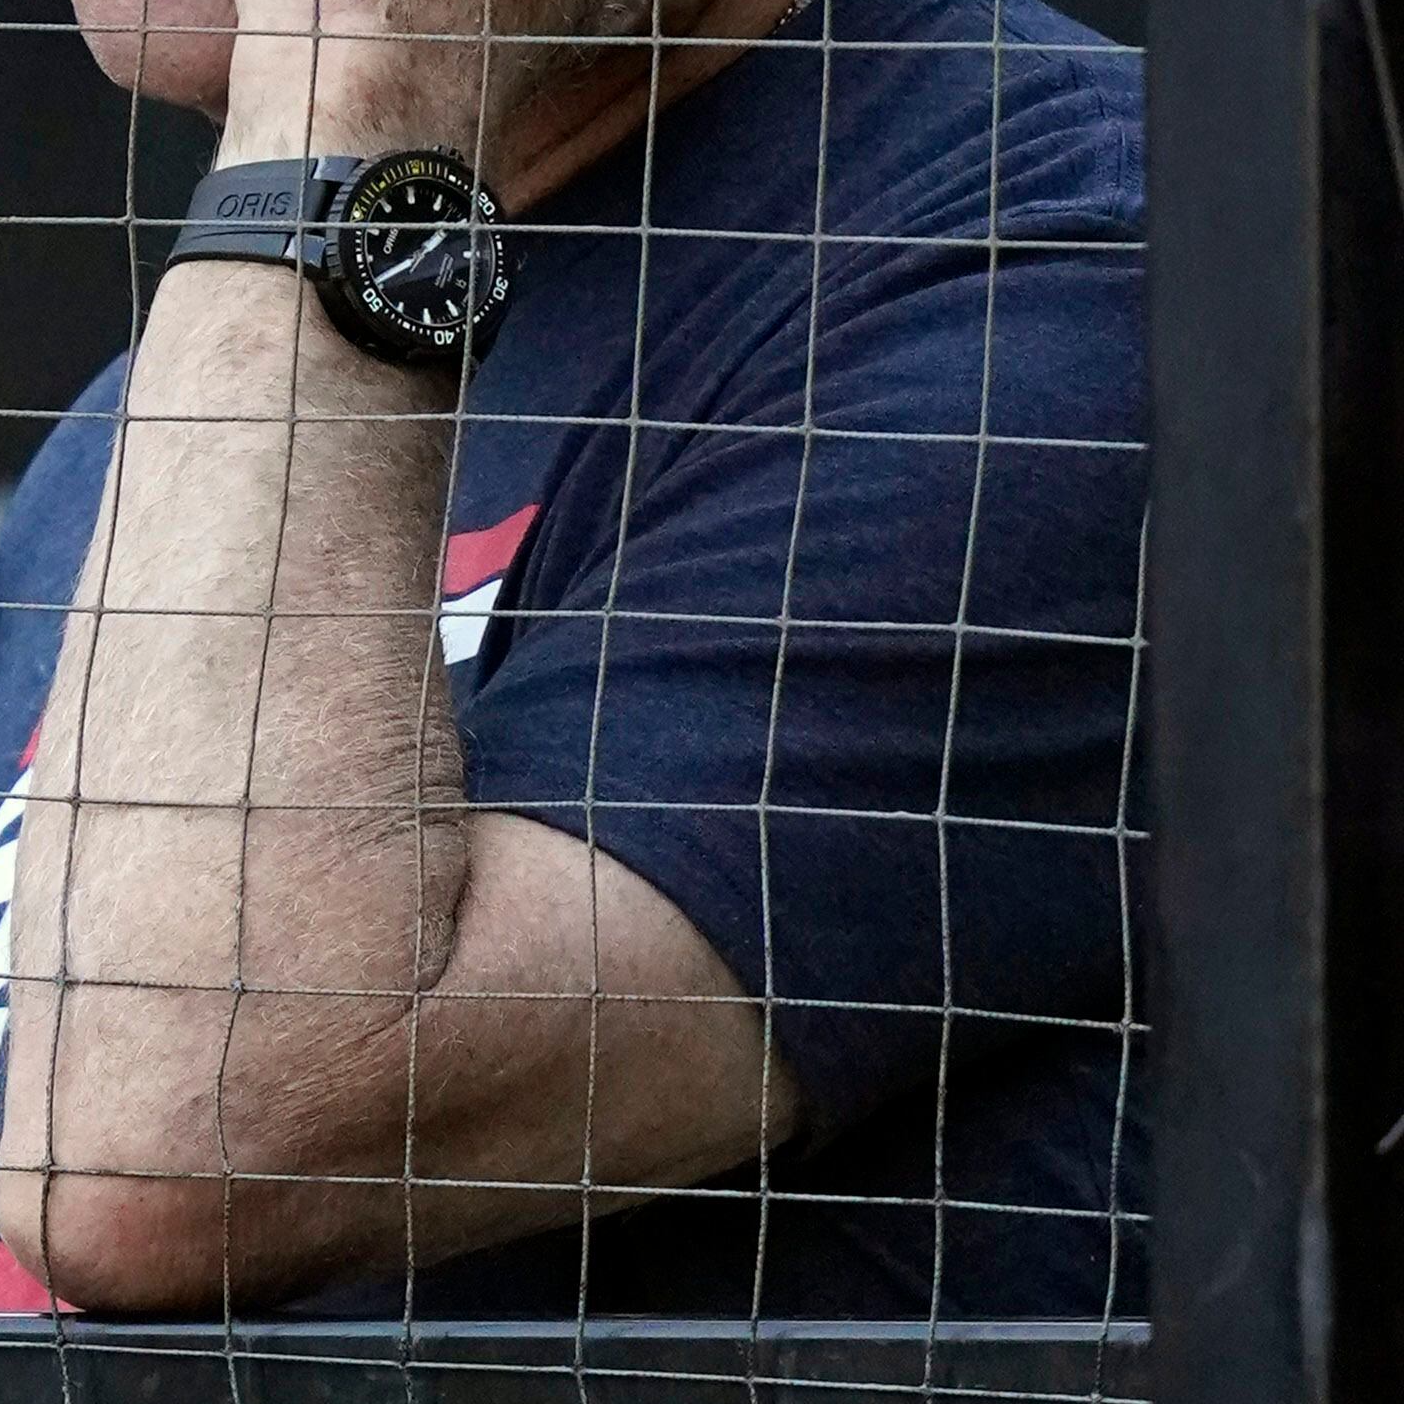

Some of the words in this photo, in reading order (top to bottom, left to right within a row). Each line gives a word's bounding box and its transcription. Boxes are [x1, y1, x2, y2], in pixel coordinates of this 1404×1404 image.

[217, 191, 293, 218] ORIS
[478, 192, 495, 216] 20
[493, 277, 508, 300] 30
[362, 289, 383, 313] 50
[434, 330, 455, 345] 40
